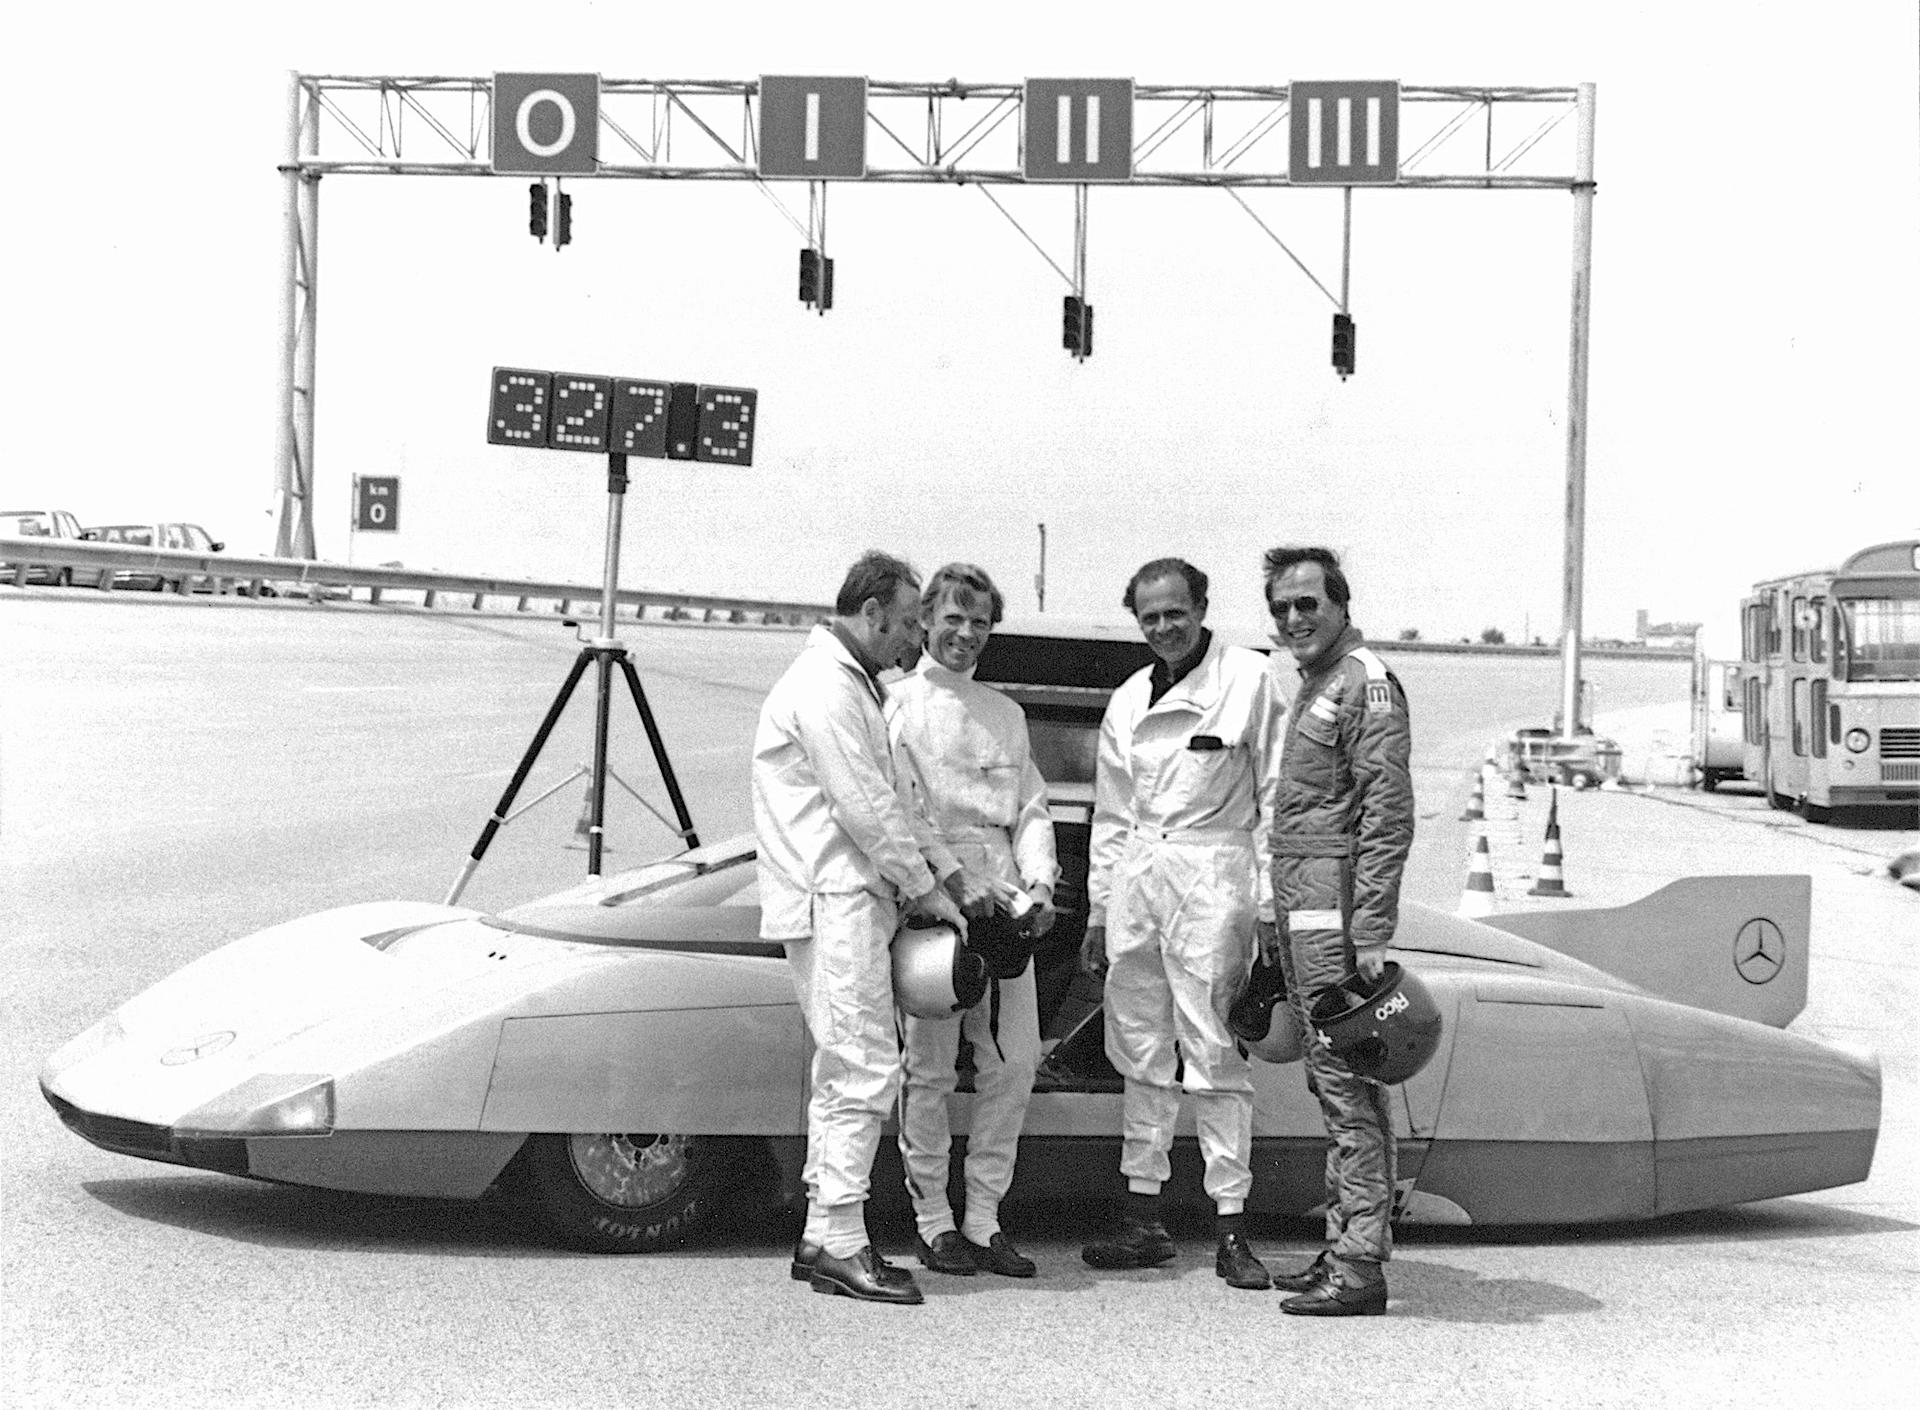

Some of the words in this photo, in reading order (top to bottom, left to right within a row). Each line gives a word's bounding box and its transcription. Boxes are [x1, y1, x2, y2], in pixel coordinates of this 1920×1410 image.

[497, 376, 750, 457] 327.3
[369, 483, 389, 496] km
[1375, 991, 1410, 1021] Rico
